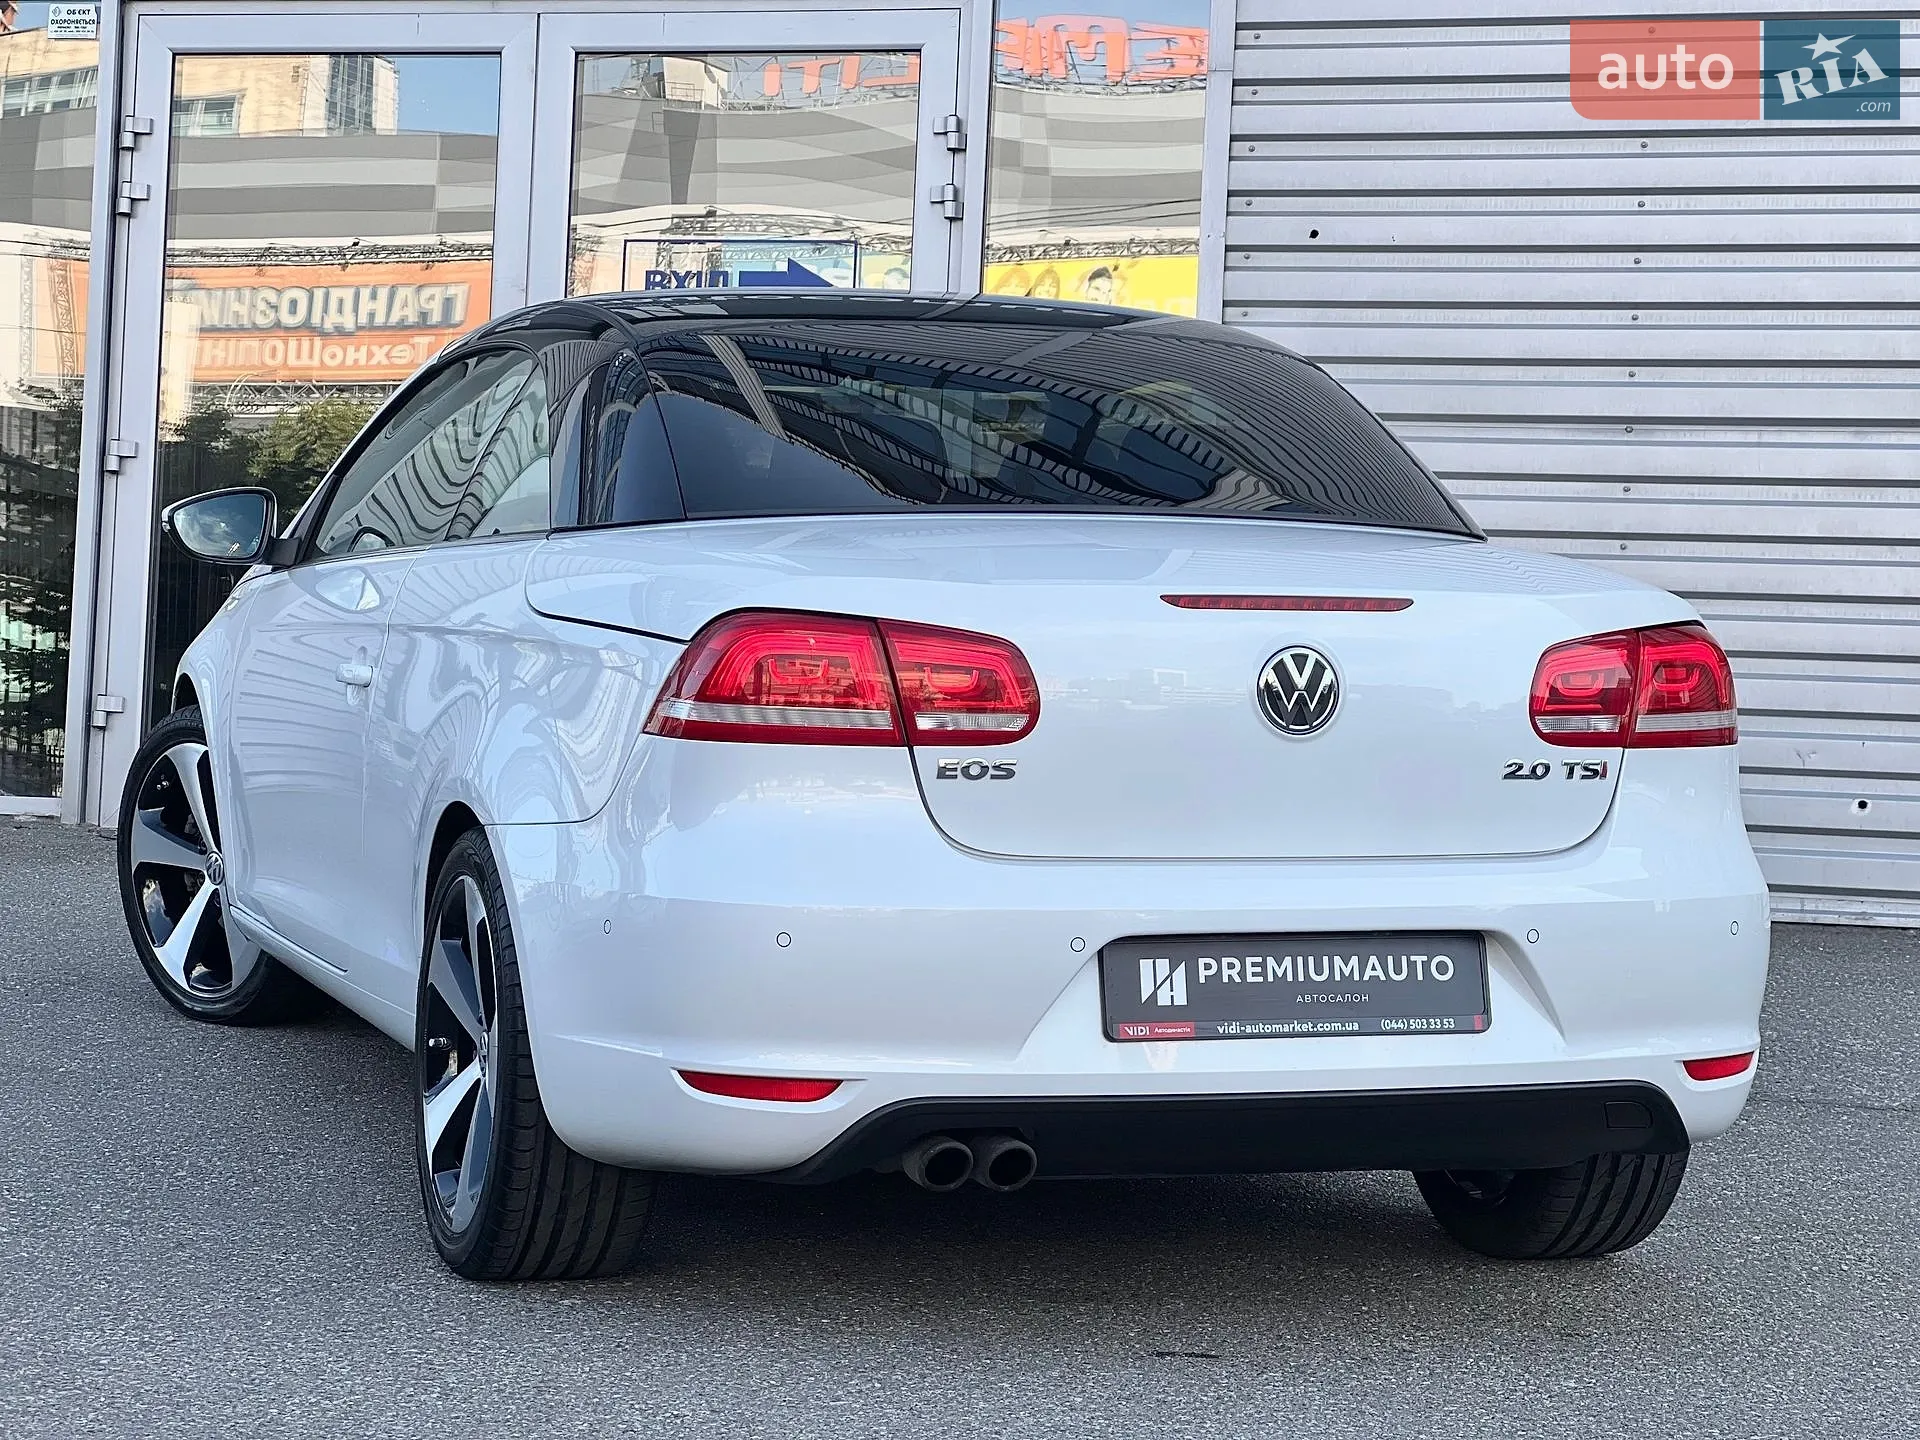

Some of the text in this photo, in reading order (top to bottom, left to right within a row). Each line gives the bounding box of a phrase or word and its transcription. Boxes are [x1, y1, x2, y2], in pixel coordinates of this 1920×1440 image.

[936, 758, 1018, 780] EOS
[1197, 955, 1456, 984] PREMIUMAUTO
[1296, 993, 1370, 1004] АВТОСАЛОН
[1124, 1026, 1150, 1036] VIDI
[1217, 1018, 1455, 1034] vidi-automarket.com.ua (044) 503 33 53
